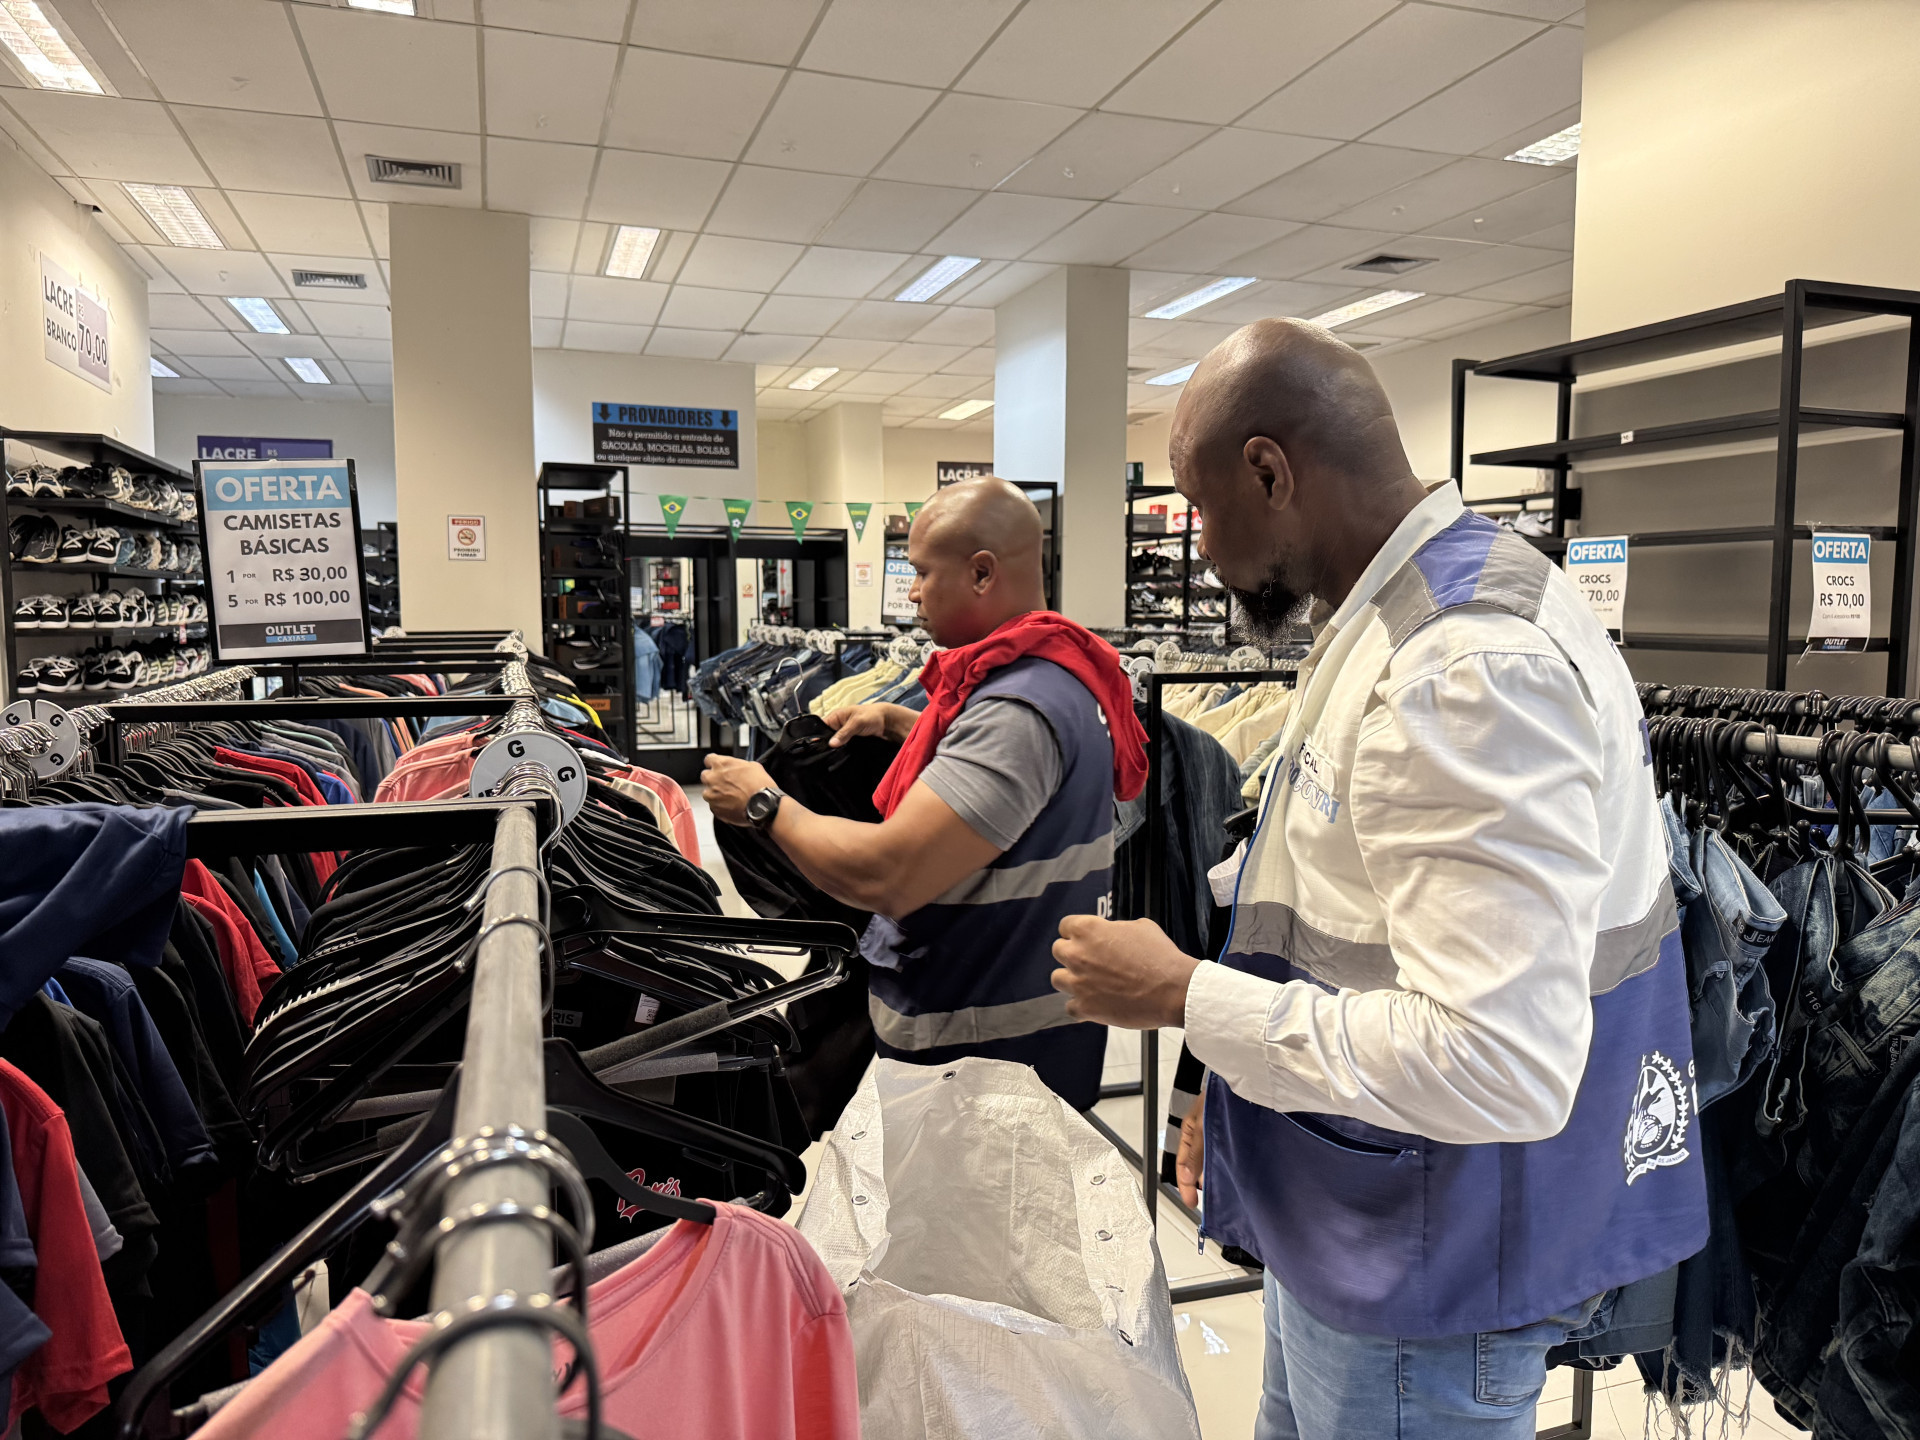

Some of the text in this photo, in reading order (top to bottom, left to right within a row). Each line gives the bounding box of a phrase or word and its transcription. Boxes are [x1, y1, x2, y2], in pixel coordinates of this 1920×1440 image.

[44, 275, 74, 317] LACRE
[46, 317, 77, 352] BRANCO
[78, 322, 107, 365] 70,00
[618, 406, 713, 426] PROVADORES
[608, 428, 626, 438] Não
[634, 431, 673, 442] permitido
[681, 433, 713, 442] entrada
[713, 434, 724, 443] de
[202, 447, 256, 460] LACRE
[601, 441, 731, 456] SACOLAS, MOCHILAS, BOLSAS
[596, 453, 606, 461] ou
[607, 453, 642, 464] qualquer
[642, 455, 666, 464] objeto
[666, 456, 677, 464] de
[215, 475, 342, 502] OFERTA
[223, 512, 341, 530] CAMISETAS
[240, 535, 329, 555] BÁSICAS
[1570, 543, 1624, 561] OFERTA
[1813, 541, 1867, 559] OFERTA
[226, 570, 235, 583] 1
[272, 568, 294, 582] R$
[299, 566, 347, 582] 30,00
[887, 562, 917, 575] OFER
[1579, 574, 1611, 584] CROCS
[1826, 575, 1855, 587] CROCS
[228, 594, 238, 608] 5
[264, 592, 287, 607] R$
[292, 590, 350, 605] 100,00
[1587, 589, 1619, 603] 70,00
[1820, 593, 1864, 609] R$ 70,00
[265, 624, 316, 636] OUTLET
[277, 634, 306, 642] CAXIAS
[1824, 638, 1849, 646] OUTLET
[6, 713, 20, 725] G
[50, 714, 63, 727] G
[507, 740, 525, 758] G
[50, 753, 64, 766] G
[557, 766, 576, 783] G
[1743, 930, 1777, 943] JEAN
